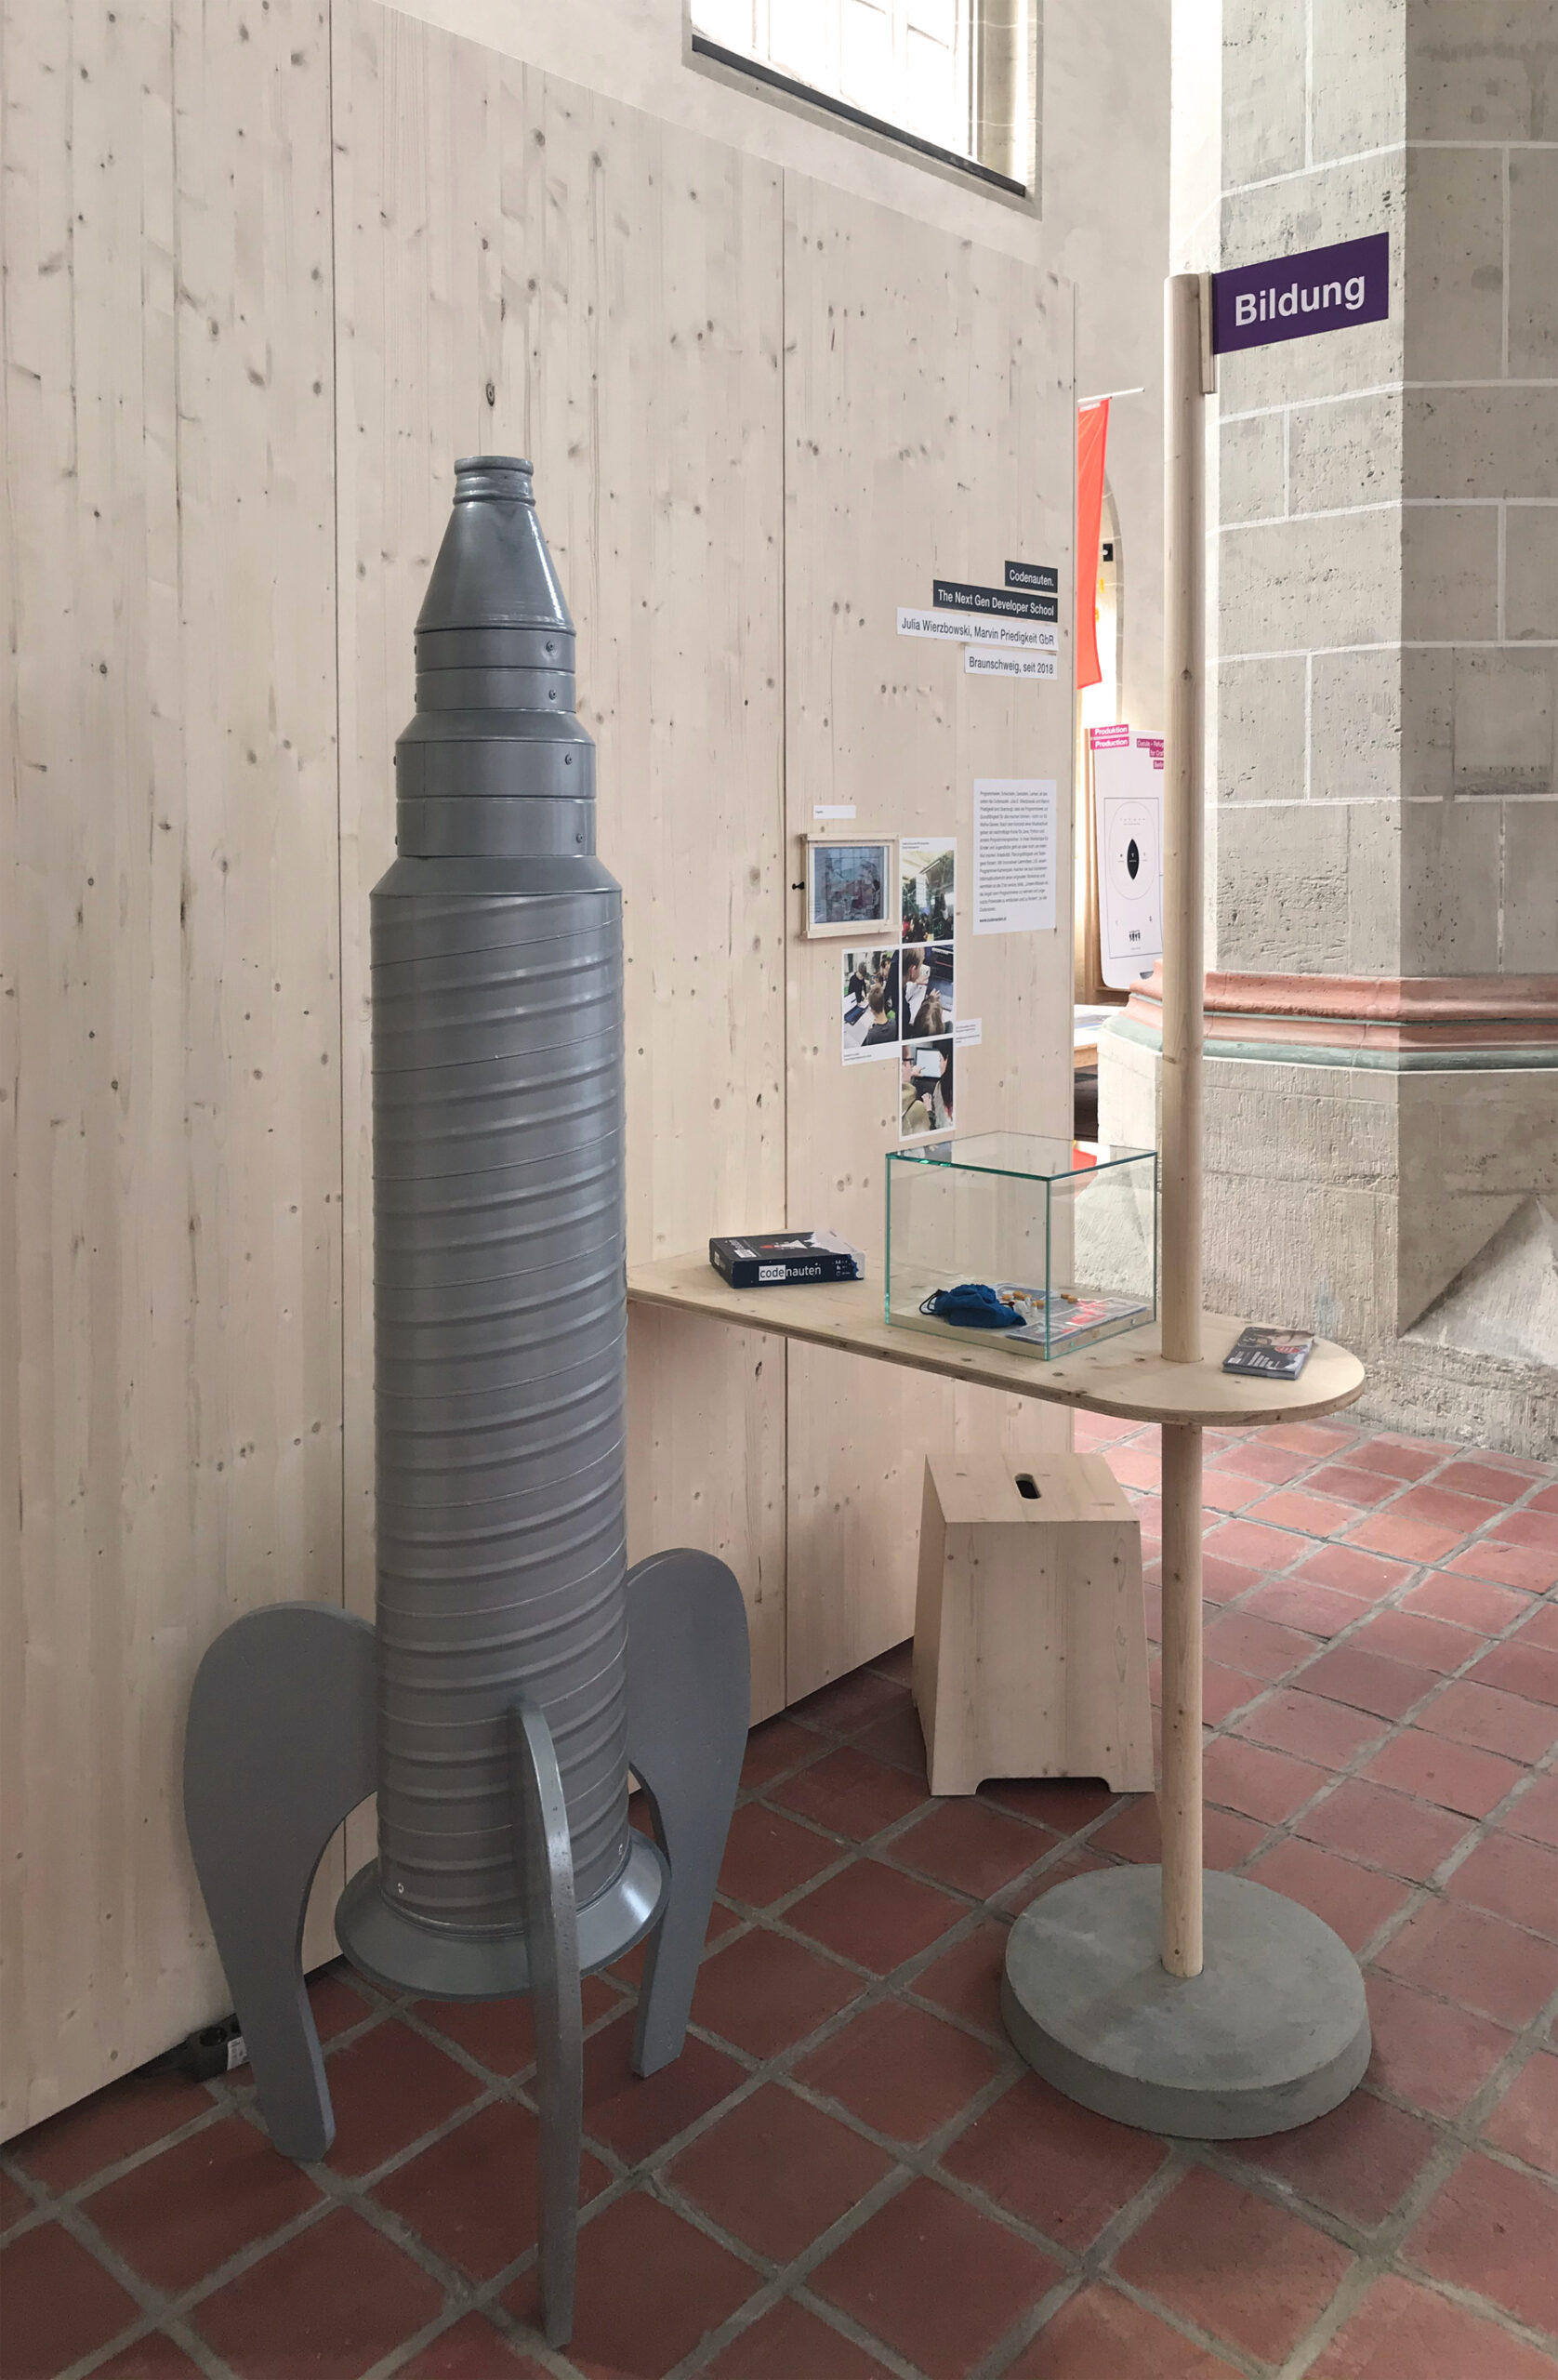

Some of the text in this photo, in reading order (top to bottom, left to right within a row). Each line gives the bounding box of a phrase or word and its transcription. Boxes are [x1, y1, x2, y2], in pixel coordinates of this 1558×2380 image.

[1235, 275, 1366, 327] Bildung
[1009, 569, 1054, 587] Codenauten.
[938, 588, 1054, 616] The Next Gen Developer School
[902, 617, 1054, 645] Julia Wierzbowski, Marvin Priedigkeit GbR
[969, 656, 1053, 674] Braunschweig, seit 2018
[1094, 726, 1128, 735] Produktion
[1095, 739, 1128, 748] Production
[759, 1265, 822, 1278] codenauten
